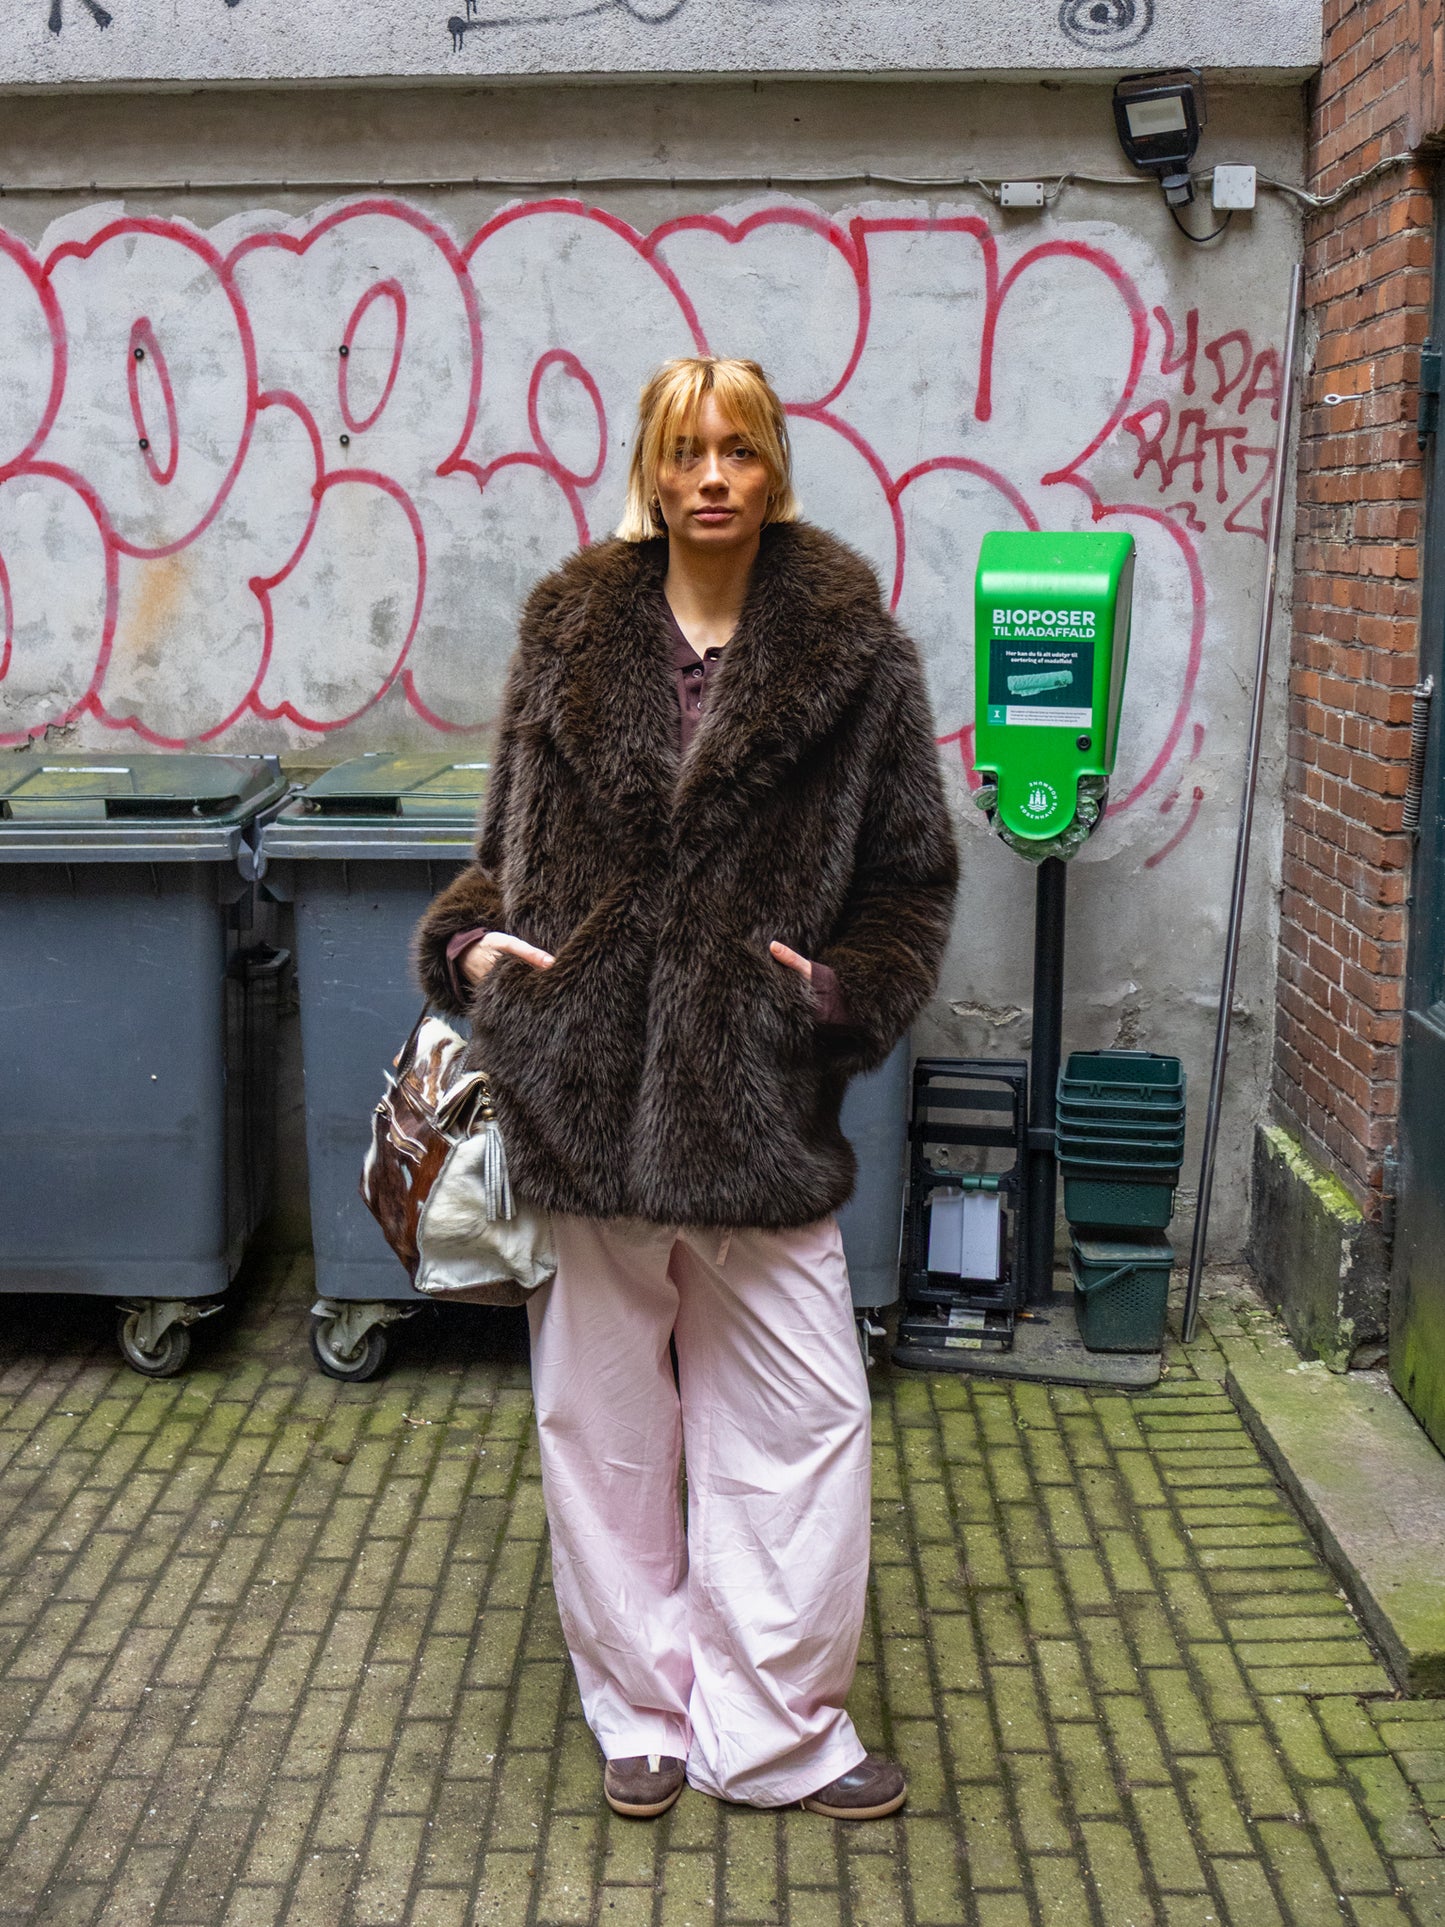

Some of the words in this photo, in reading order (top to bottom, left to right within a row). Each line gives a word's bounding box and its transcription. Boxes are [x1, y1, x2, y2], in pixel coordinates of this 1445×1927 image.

[992, 609, 1096, 626] BIOPOSER
[993, 626, 1011, 636] TIL
[1014, 627, 1096, 638] MADAFFALD
